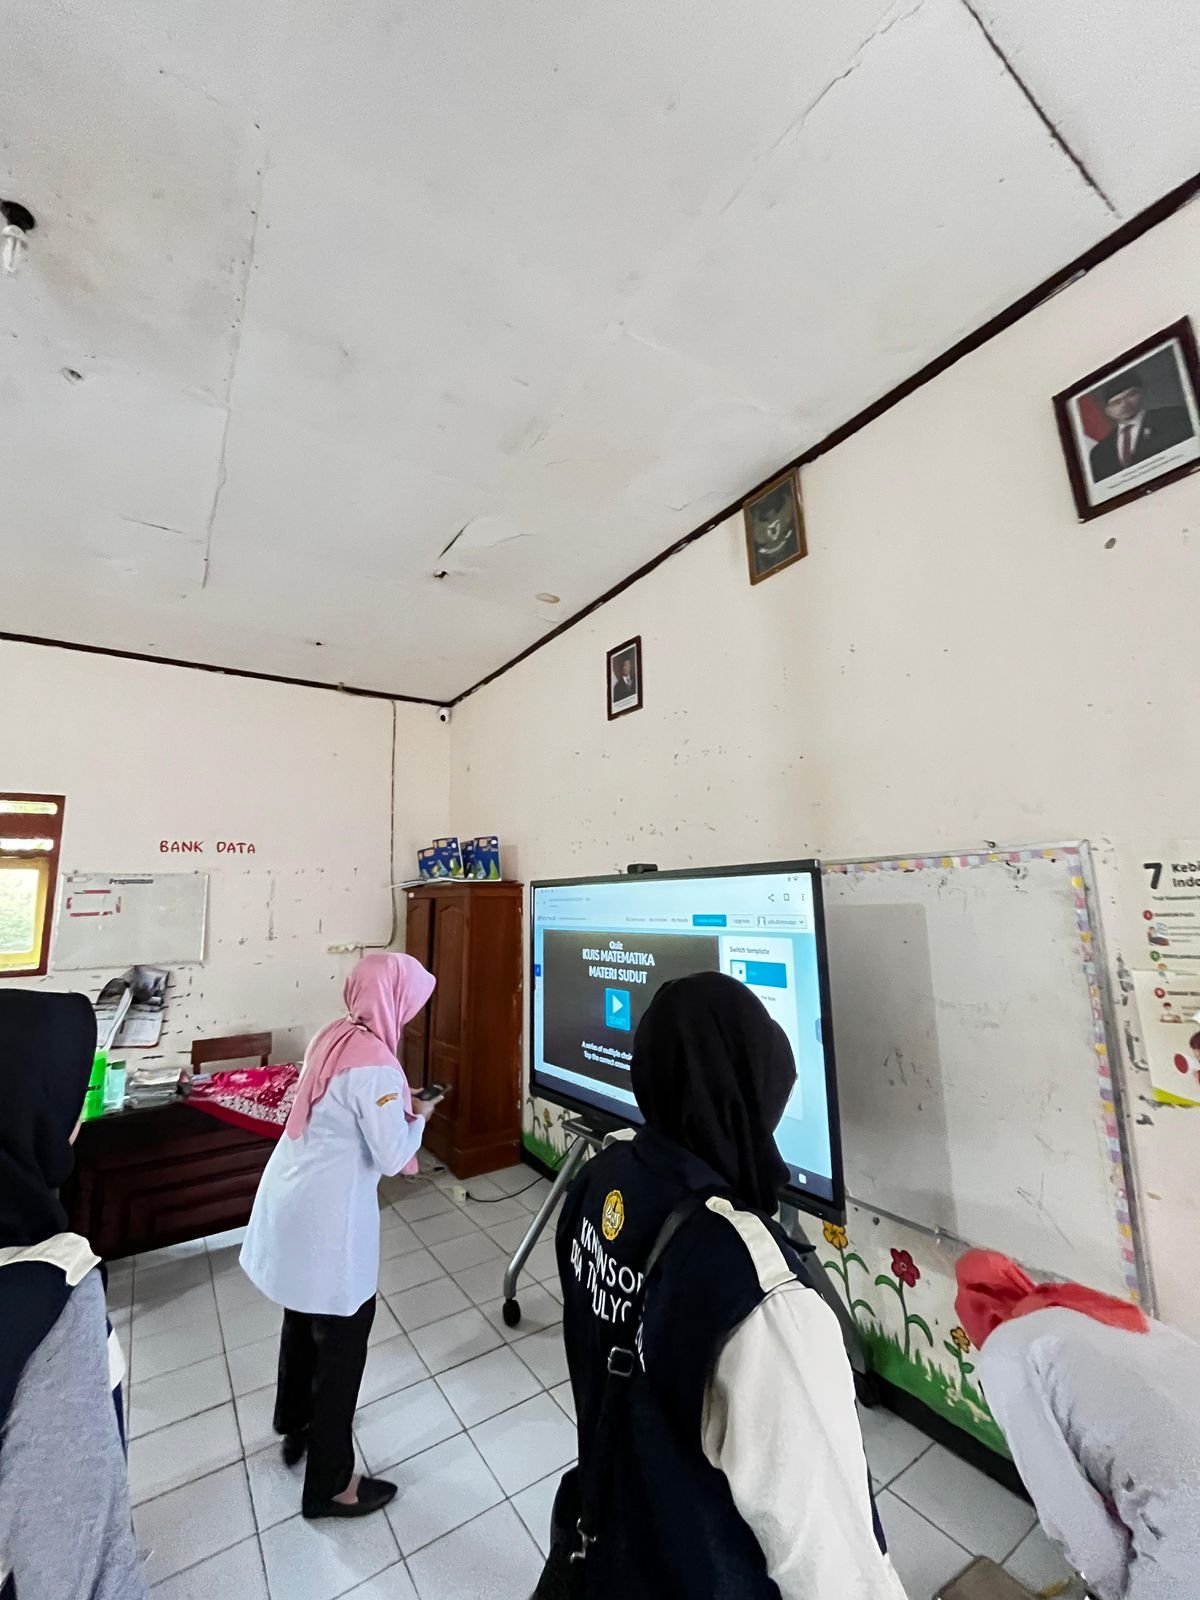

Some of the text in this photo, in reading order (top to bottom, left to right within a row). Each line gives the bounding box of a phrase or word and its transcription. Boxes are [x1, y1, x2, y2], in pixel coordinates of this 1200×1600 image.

[159, 840, 256, 854] BANK DATA
[1143, 862, 1162, 890] 7
[582, 948, 656, 966] KUIS MATEMATIKA
[589, 966, 648, 984] MATERI SUDUT
